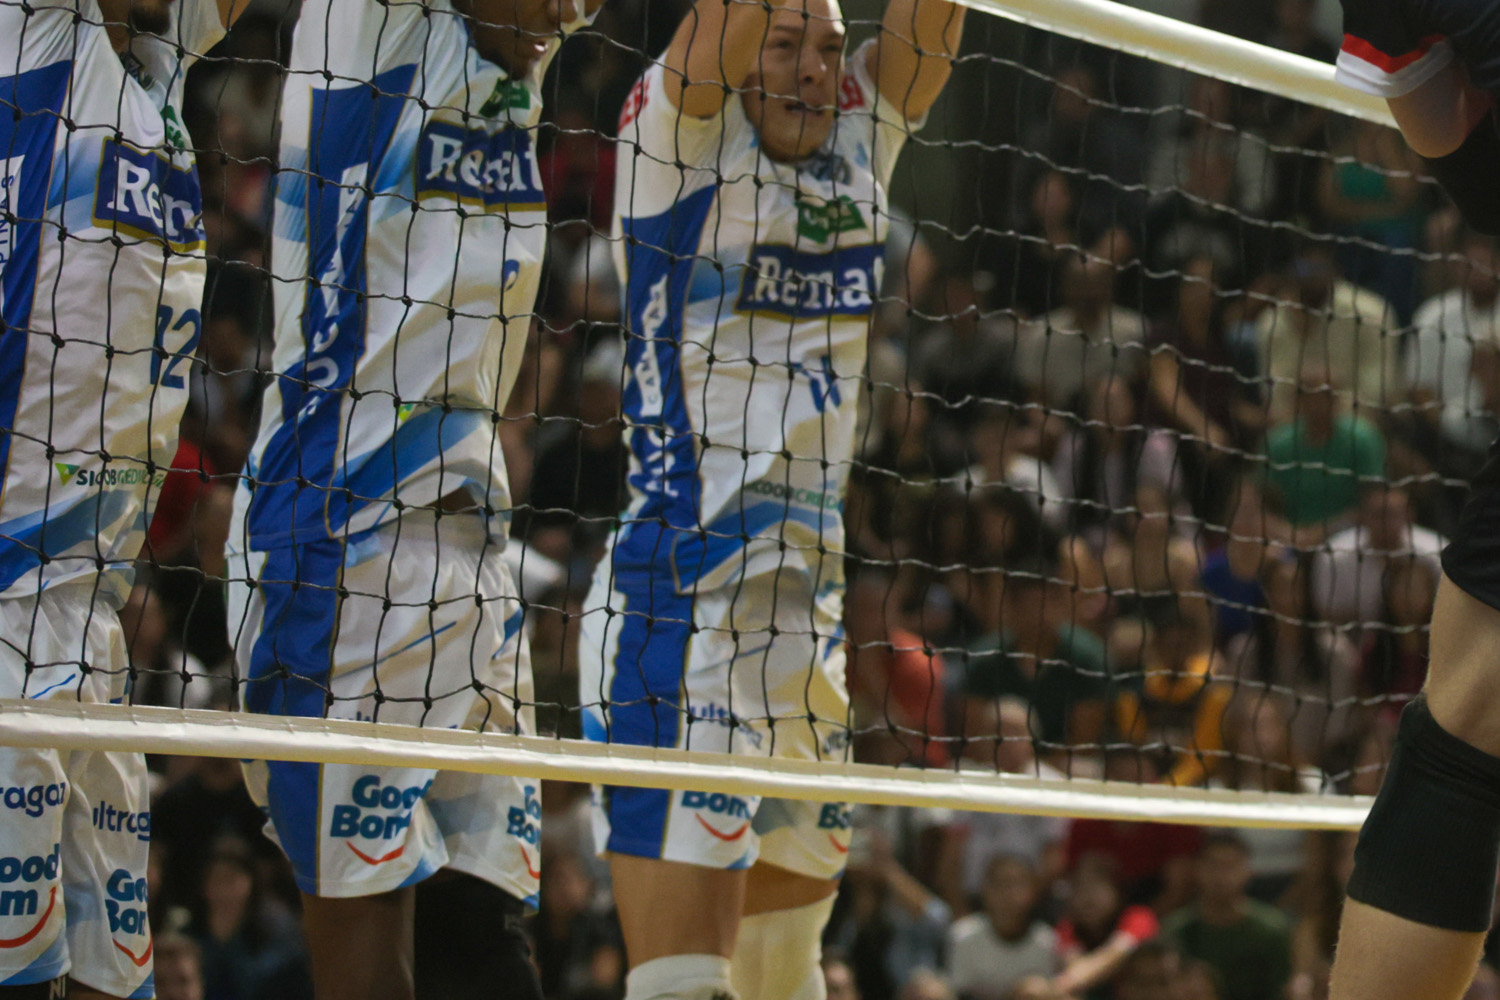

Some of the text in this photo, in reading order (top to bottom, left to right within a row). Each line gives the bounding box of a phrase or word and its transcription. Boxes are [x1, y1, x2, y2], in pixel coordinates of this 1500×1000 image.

[106, 156, 204, 237] Ren
[426, 133, 544, 195] Reat
[150, 304, 201, 390] 12
